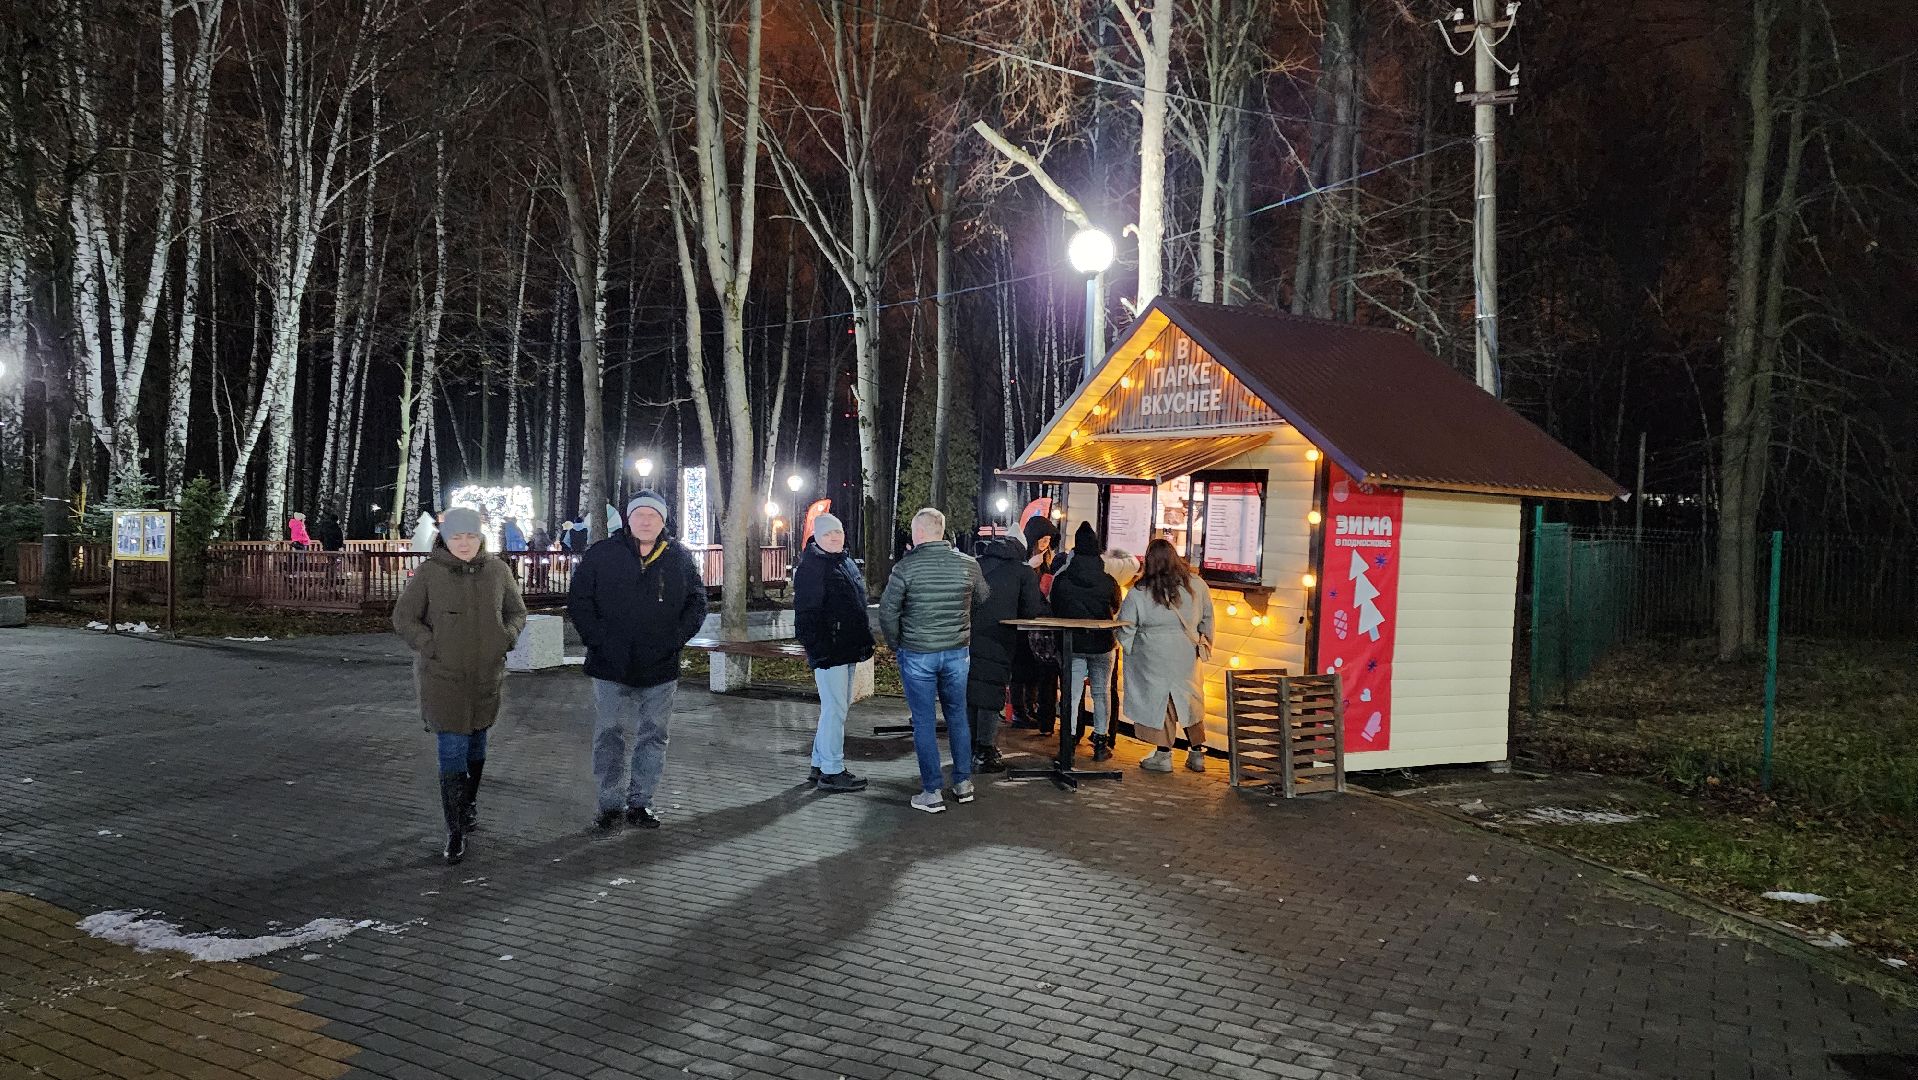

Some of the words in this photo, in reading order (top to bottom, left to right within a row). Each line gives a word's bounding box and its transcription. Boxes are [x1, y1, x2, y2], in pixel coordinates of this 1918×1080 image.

[1177, 337, 1189, 360] В
[1153, 362, 1212, 388] ПАРКЕ
[1141, 388, 1222, 416] ВКУСНЕЕ
[1335, 515, 1393, 536] ЗИМА
